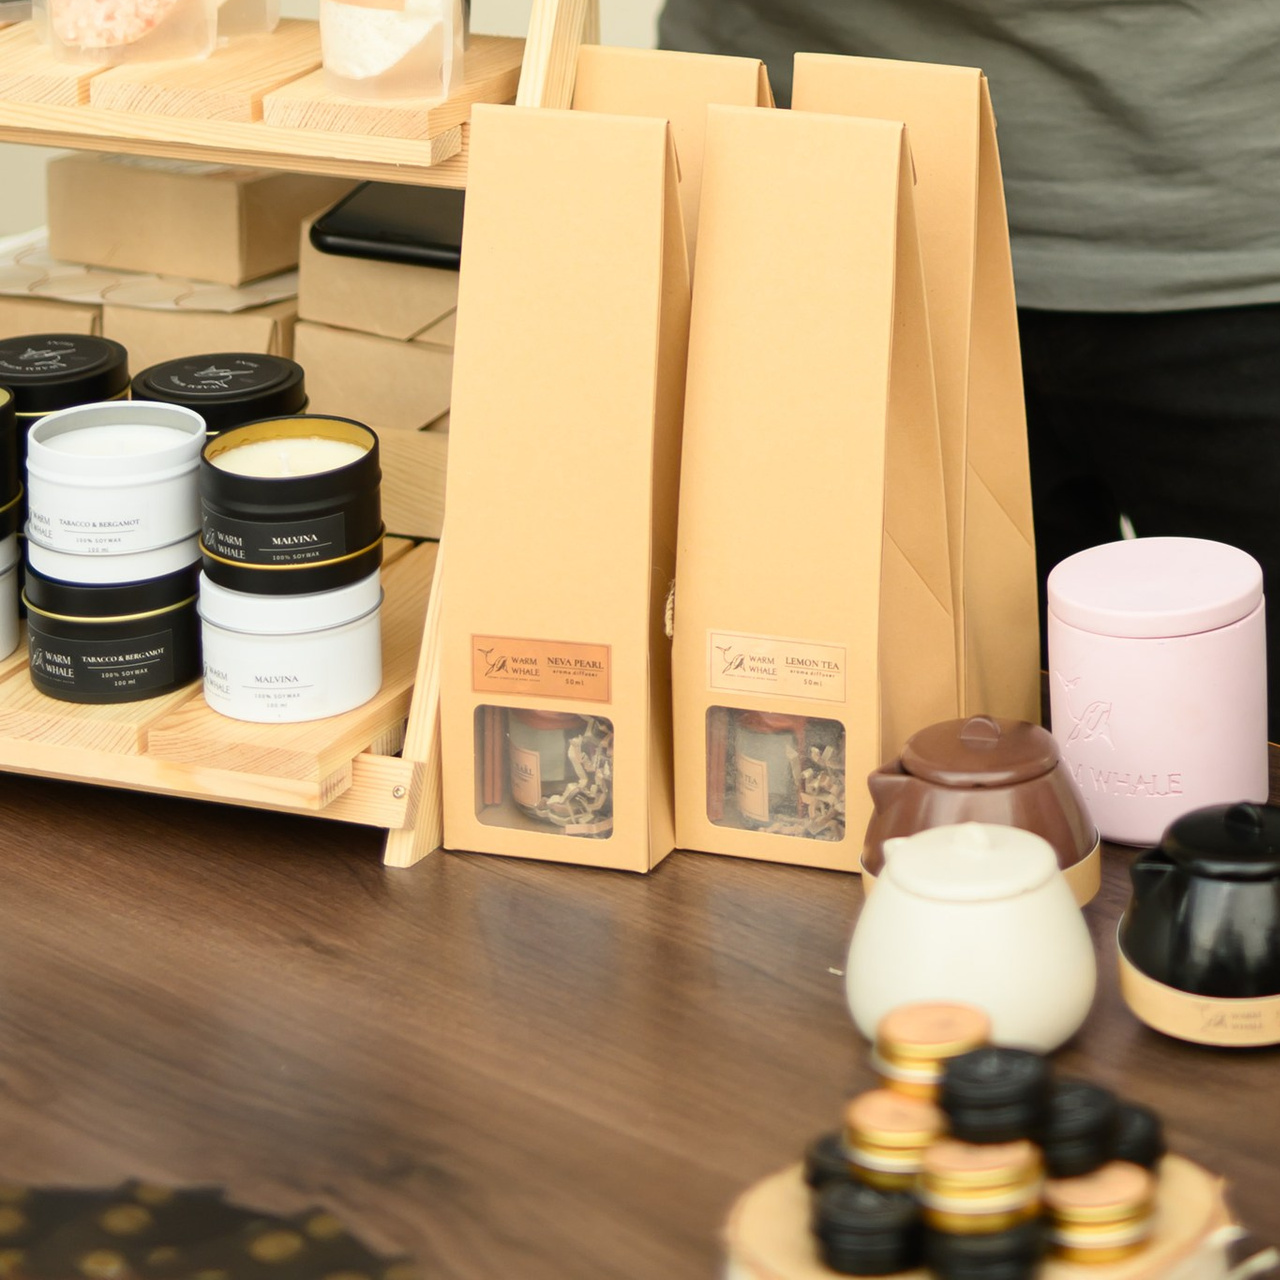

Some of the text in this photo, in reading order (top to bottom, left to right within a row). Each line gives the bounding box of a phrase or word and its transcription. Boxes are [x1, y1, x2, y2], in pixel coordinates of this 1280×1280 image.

[58, 518, 90, 528] TABACCO
[99, 518, 141, 528] BERGAMOT
[217, 531, 243, 547] WARM
[271, 534, 318, 545] MALVINA
[218, 545, 246, 559] WHALE
[272, 551, 320, 561] 100% SOYWAX
[45, 651, 71, 666] WARM
[81, 655, 118, 663] TABACCO
[125, 647, 165, 661] BERGAMOT
[748, 655, 775, 665] WARM
[511, 656, 538, 666] WARM
[547, 657, 605, 670] NEVA PEARL
[785, 657, 840, 670] LEMON TEA
[45, 664, 75, 678] WHALE
[101, 668, 149, 679] 100% SOYWAX
[511, 667, 540, 677] WHALE
[748, 666, 778, 676] WHALE
[254, 675, 300, 684] MALVINA
[565, 678, 585, 686] 50ml
[803, 679, 823, 687] 50ml
[1089, 766, 1183, 798] WHALE
